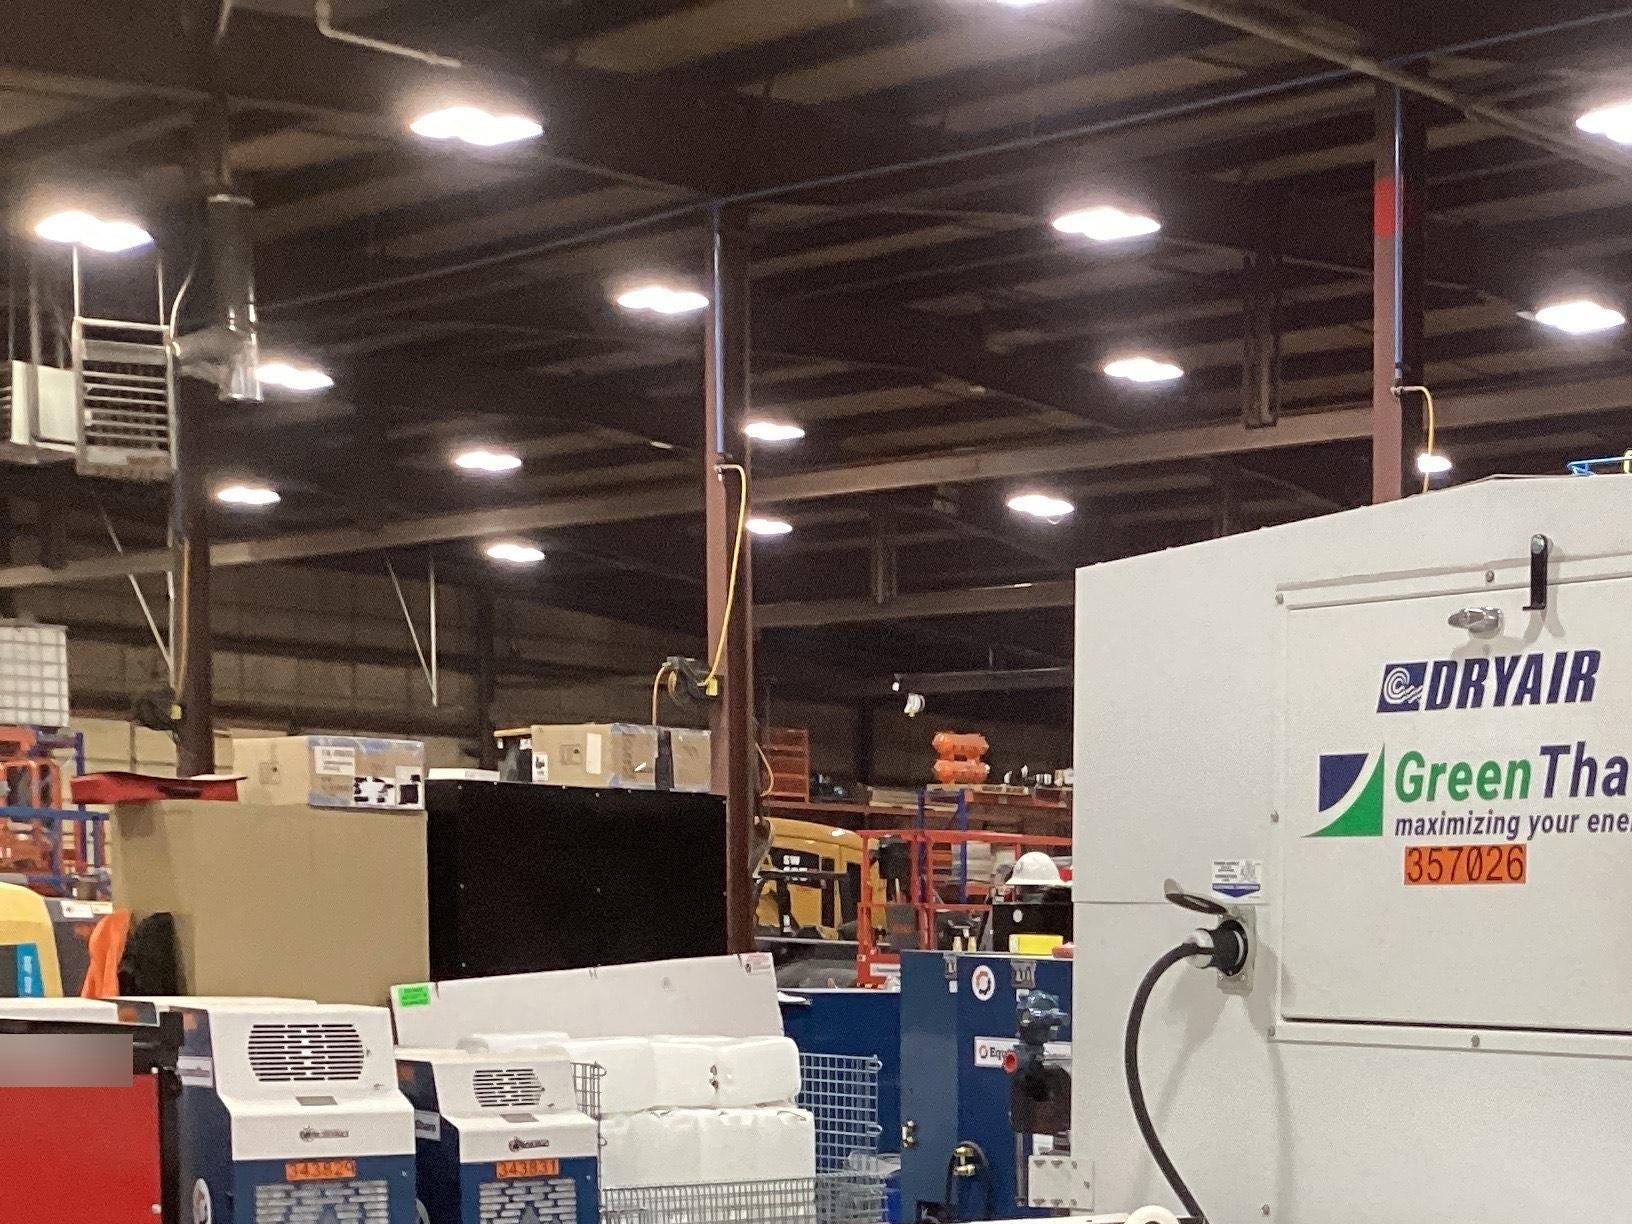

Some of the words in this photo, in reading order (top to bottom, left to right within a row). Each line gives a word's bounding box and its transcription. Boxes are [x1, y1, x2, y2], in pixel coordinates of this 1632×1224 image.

[1425, 648, 1602, 711] DRYAIR
[1394, 809, 1520, 841] maximizing
[1527, 812, 1579, 841] your
[1406, 845, 1526, 883] 357026
